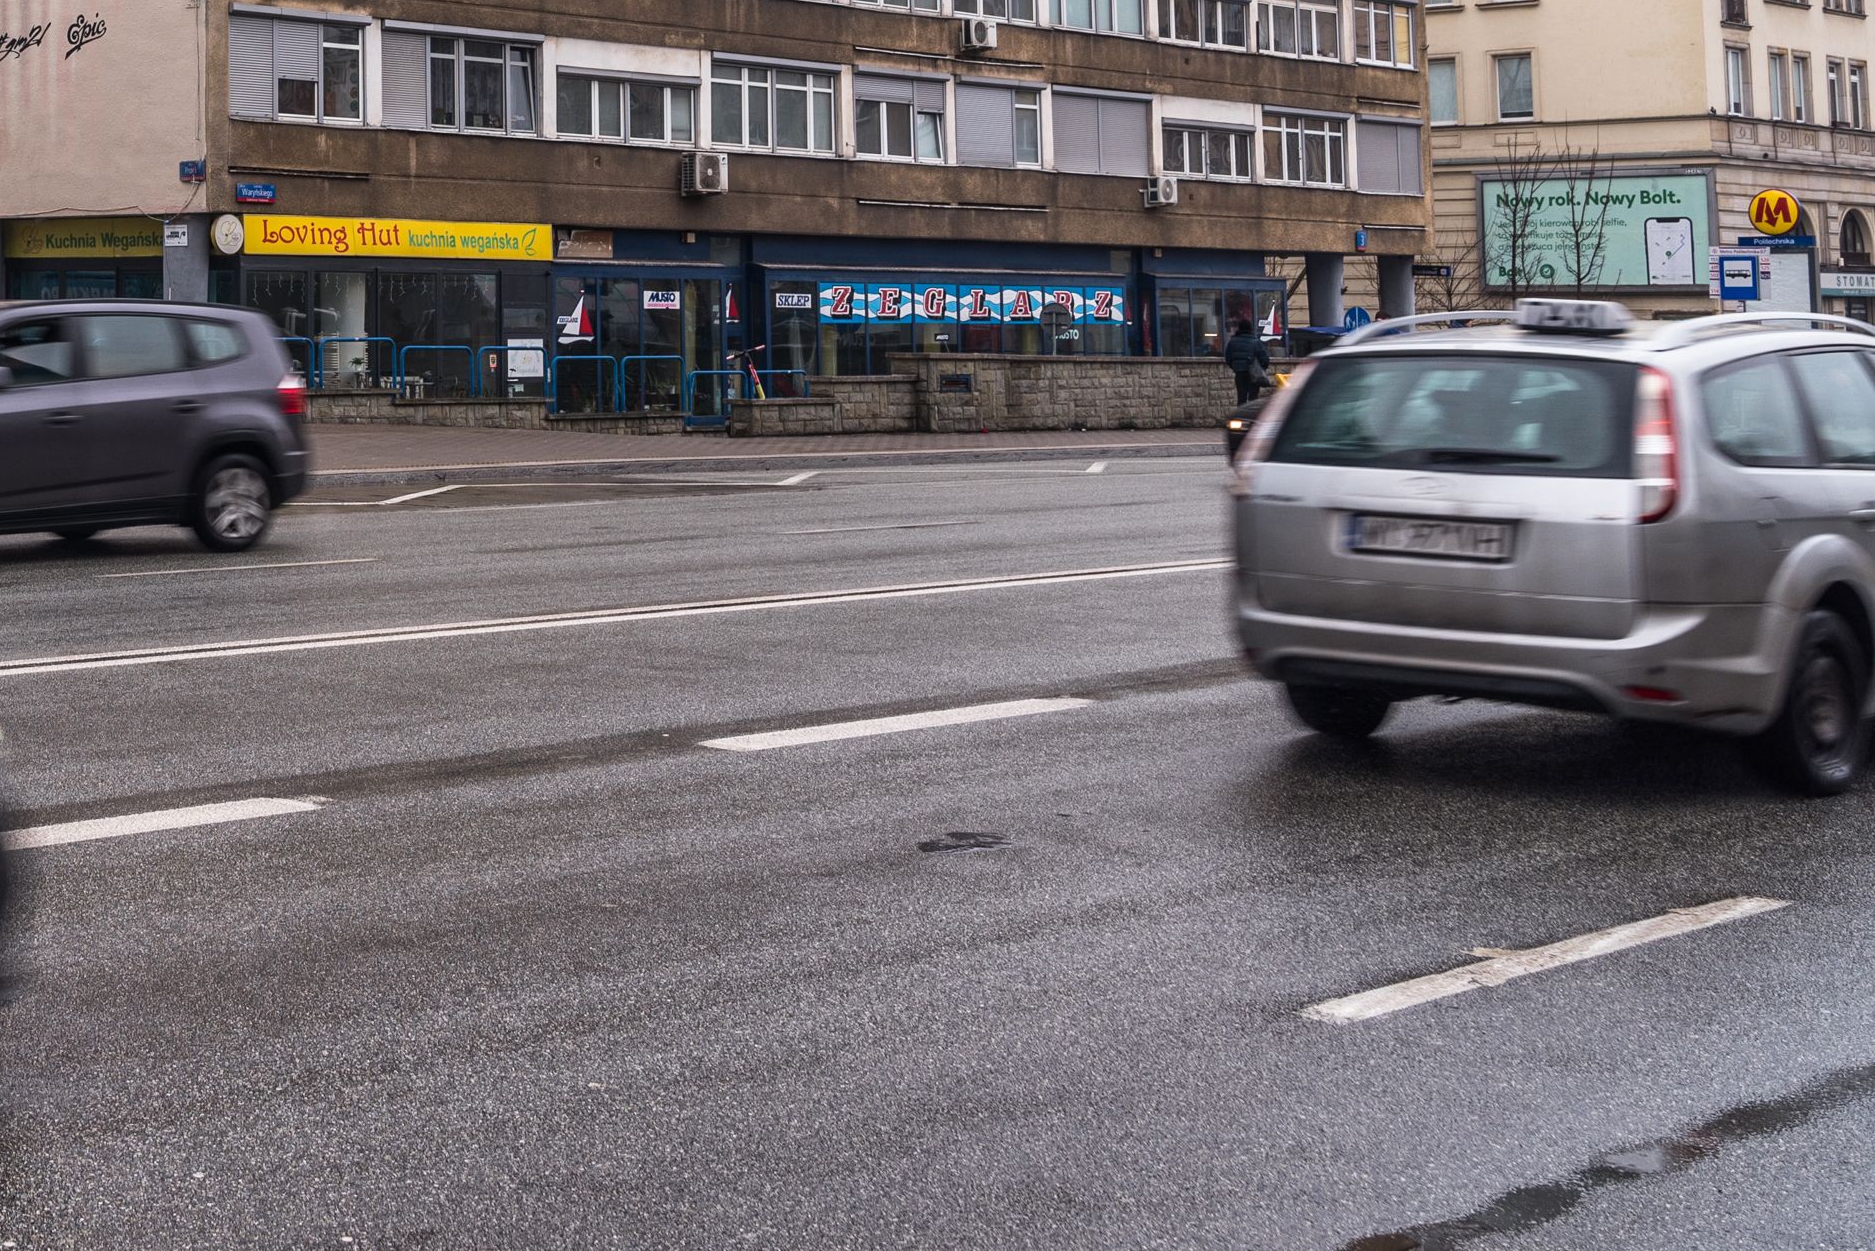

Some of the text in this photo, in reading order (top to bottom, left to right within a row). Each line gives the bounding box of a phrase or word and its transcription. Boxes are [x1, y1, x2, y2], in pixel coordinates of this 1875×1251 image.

[64, 12, 108, 60] Epic
[1496, 189, 1681, 210] Nowy rok. Nowy Bolt.
[46, 234, 96, 248] Kuchnia
[261, 219, 518, 253] Loving Hut kuchnia wegańska
[1359, 235, 1365, 246] 3
[648, 292, 676, 302] MUSTO
[777, 295, 810, 307] SKLEP
